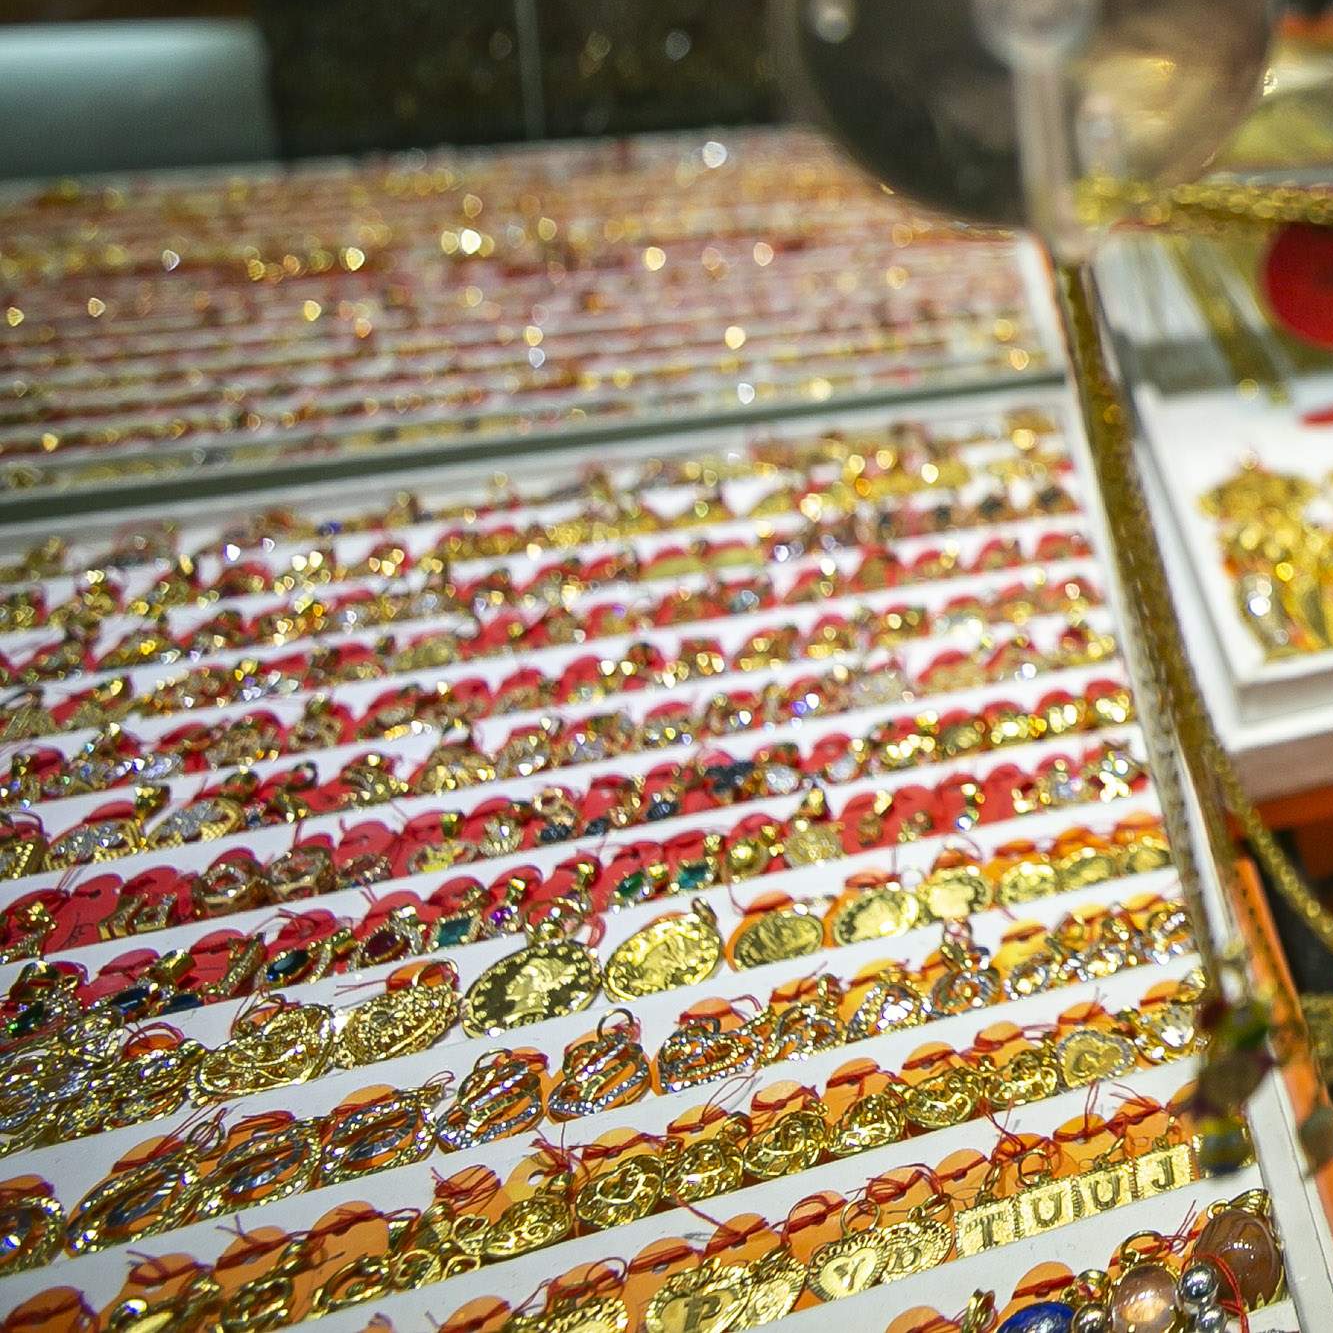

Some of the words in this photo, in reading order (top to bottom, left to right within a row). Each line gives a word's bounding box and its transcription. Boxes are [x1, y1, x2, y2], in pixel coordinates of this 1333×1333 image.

[964, 1211, 1004, 1249] T
[1031, 1191, 1063, 1228] U
[1090, 1173, 1122, 1210] U
[1151, 1155, 1176, 1189] J
[684, 1294, 721, 1333] P
